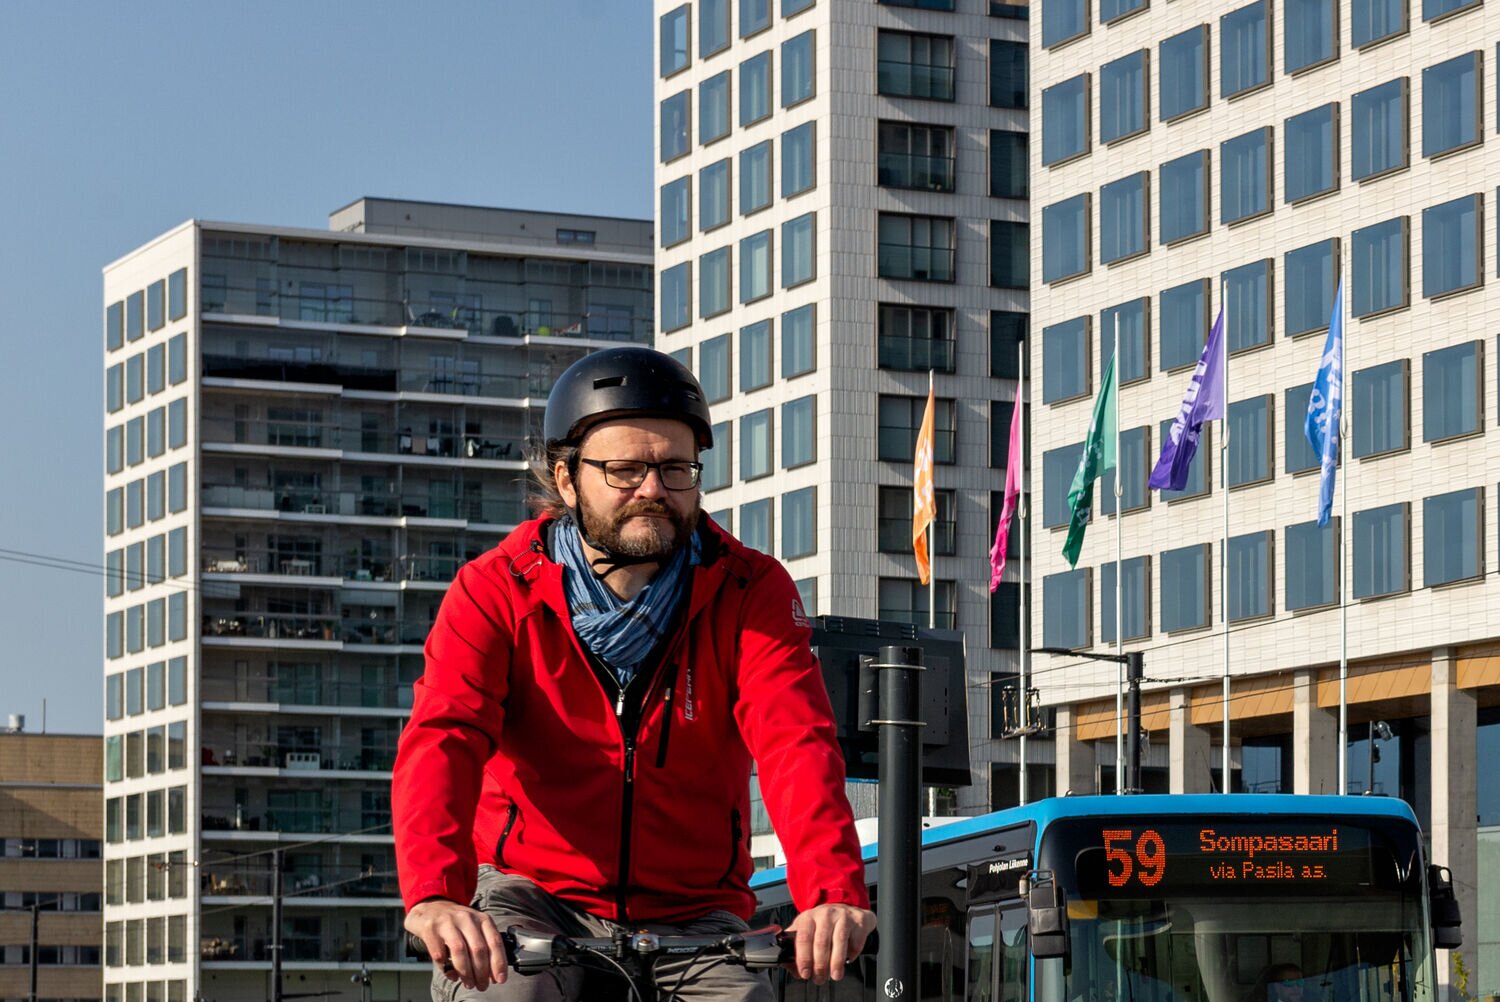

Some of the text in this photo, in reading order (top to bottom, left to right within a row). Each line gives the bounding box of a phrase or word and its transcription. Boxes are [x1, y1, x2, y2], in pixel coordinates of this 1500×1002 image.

[1199, 828, 1338, 858] Sompasaari
[989, 858, 1028, 874] Pohjolan Liikenne
[1102, 829, 1165, 886] 59
[1210, 861, 1236, 879] via
[1242, 861, 1294, 879] Pasila
